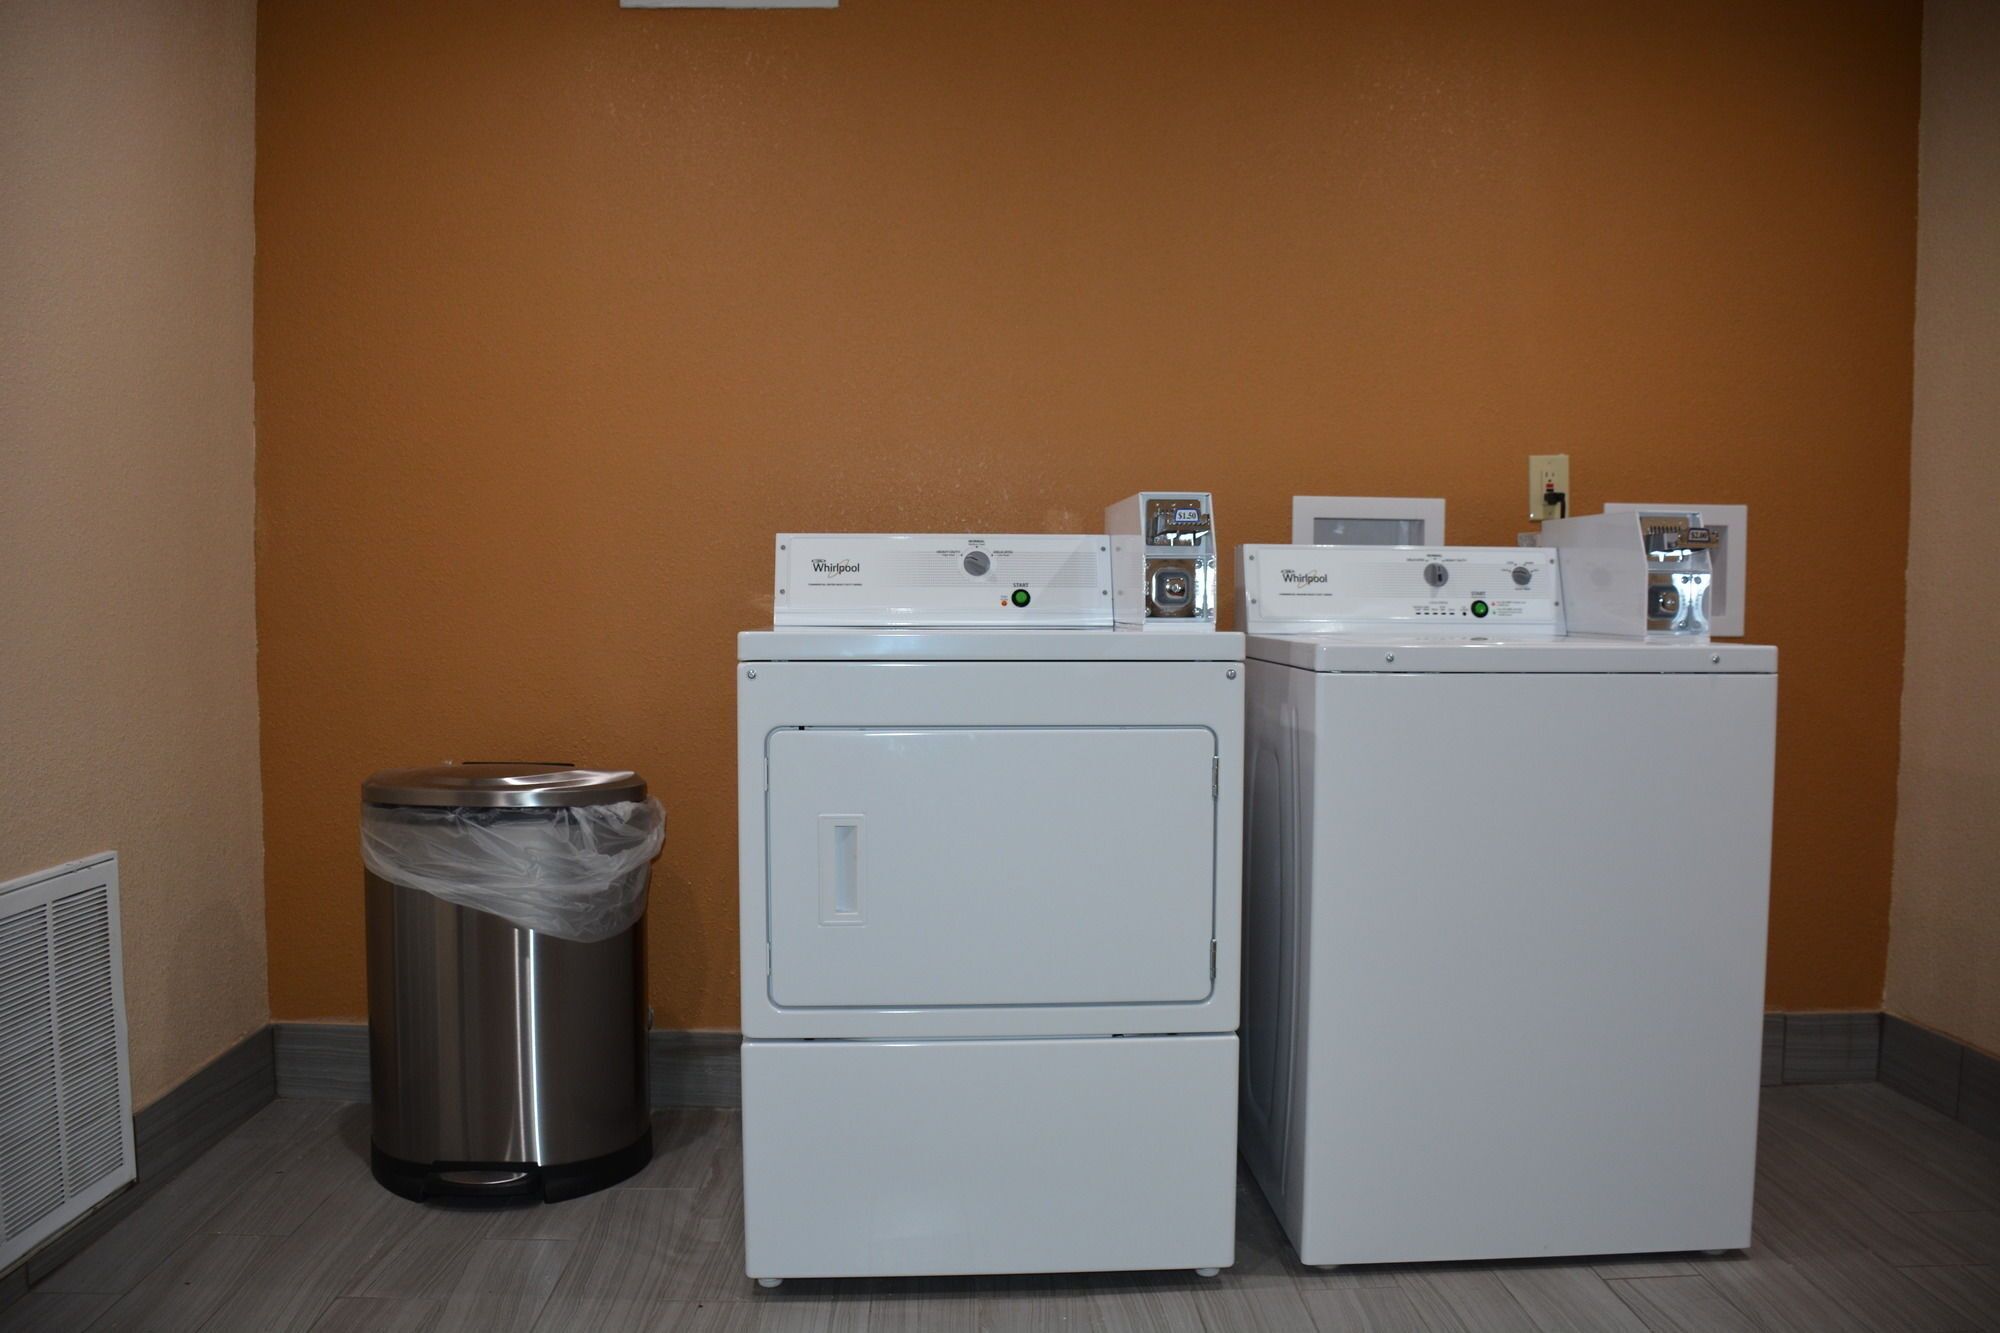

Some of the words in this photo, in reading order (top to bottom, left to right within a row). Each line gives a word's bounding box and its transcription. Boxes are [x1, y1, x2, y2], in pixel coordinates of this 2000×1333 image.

[1178, 511, 1197, 520] $1.50
[812, 562, 860, 575] Whirlpool
[1281, 573, 1328, 585] Whirlpool
